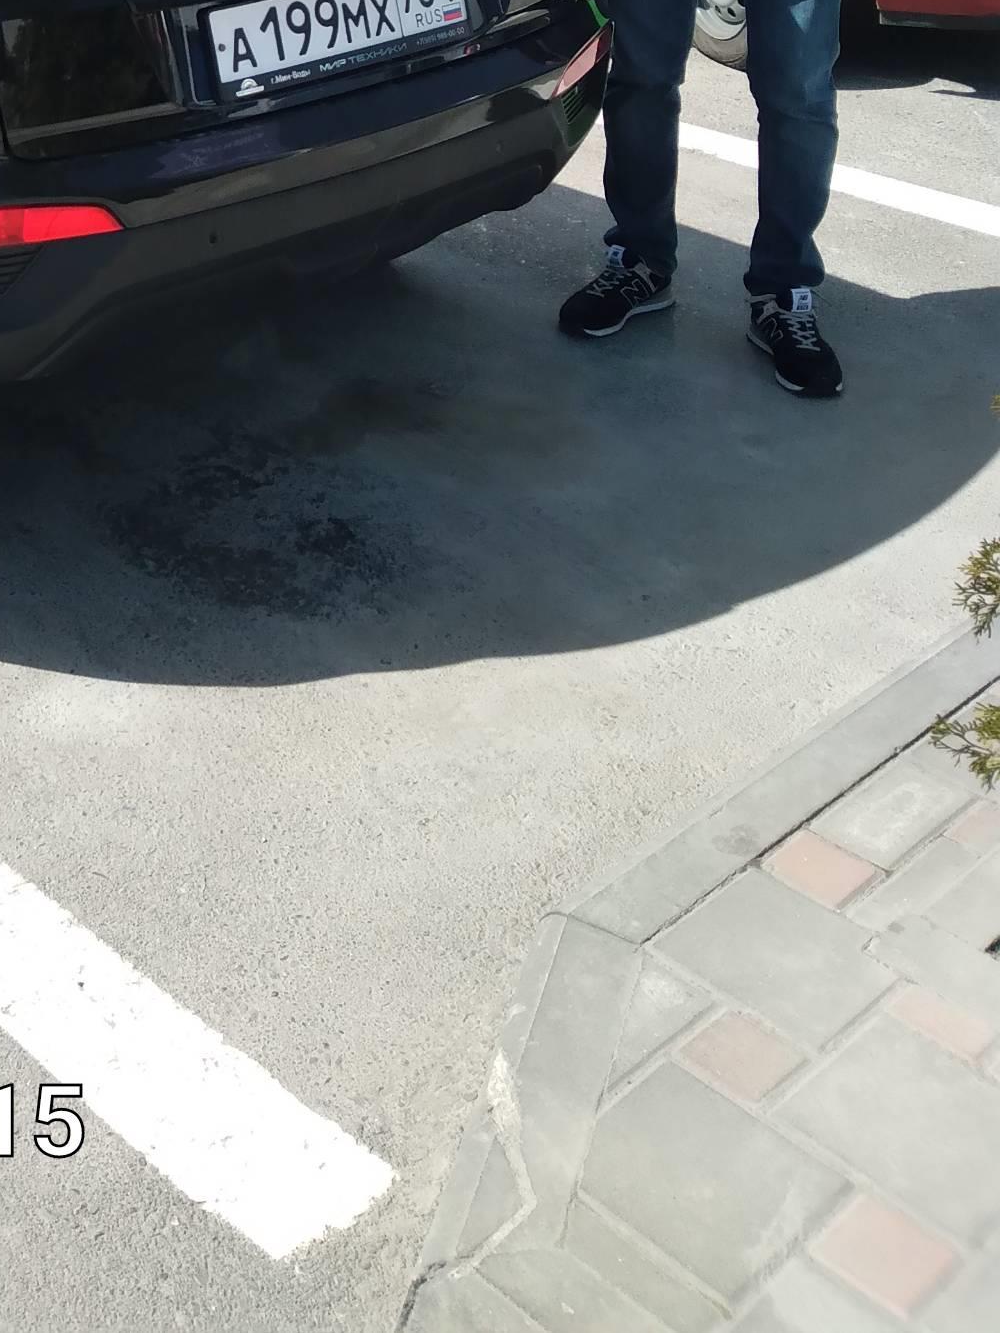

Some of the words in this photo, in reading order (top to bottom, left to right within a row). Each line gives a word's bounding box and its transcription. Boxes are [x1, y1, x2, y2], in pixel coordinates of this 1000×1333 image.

[416, 8, 443, 28] RUS
[319, 58, 347, 72] МИР
[350, 42, 408, 65] ТЕХНИКИ
